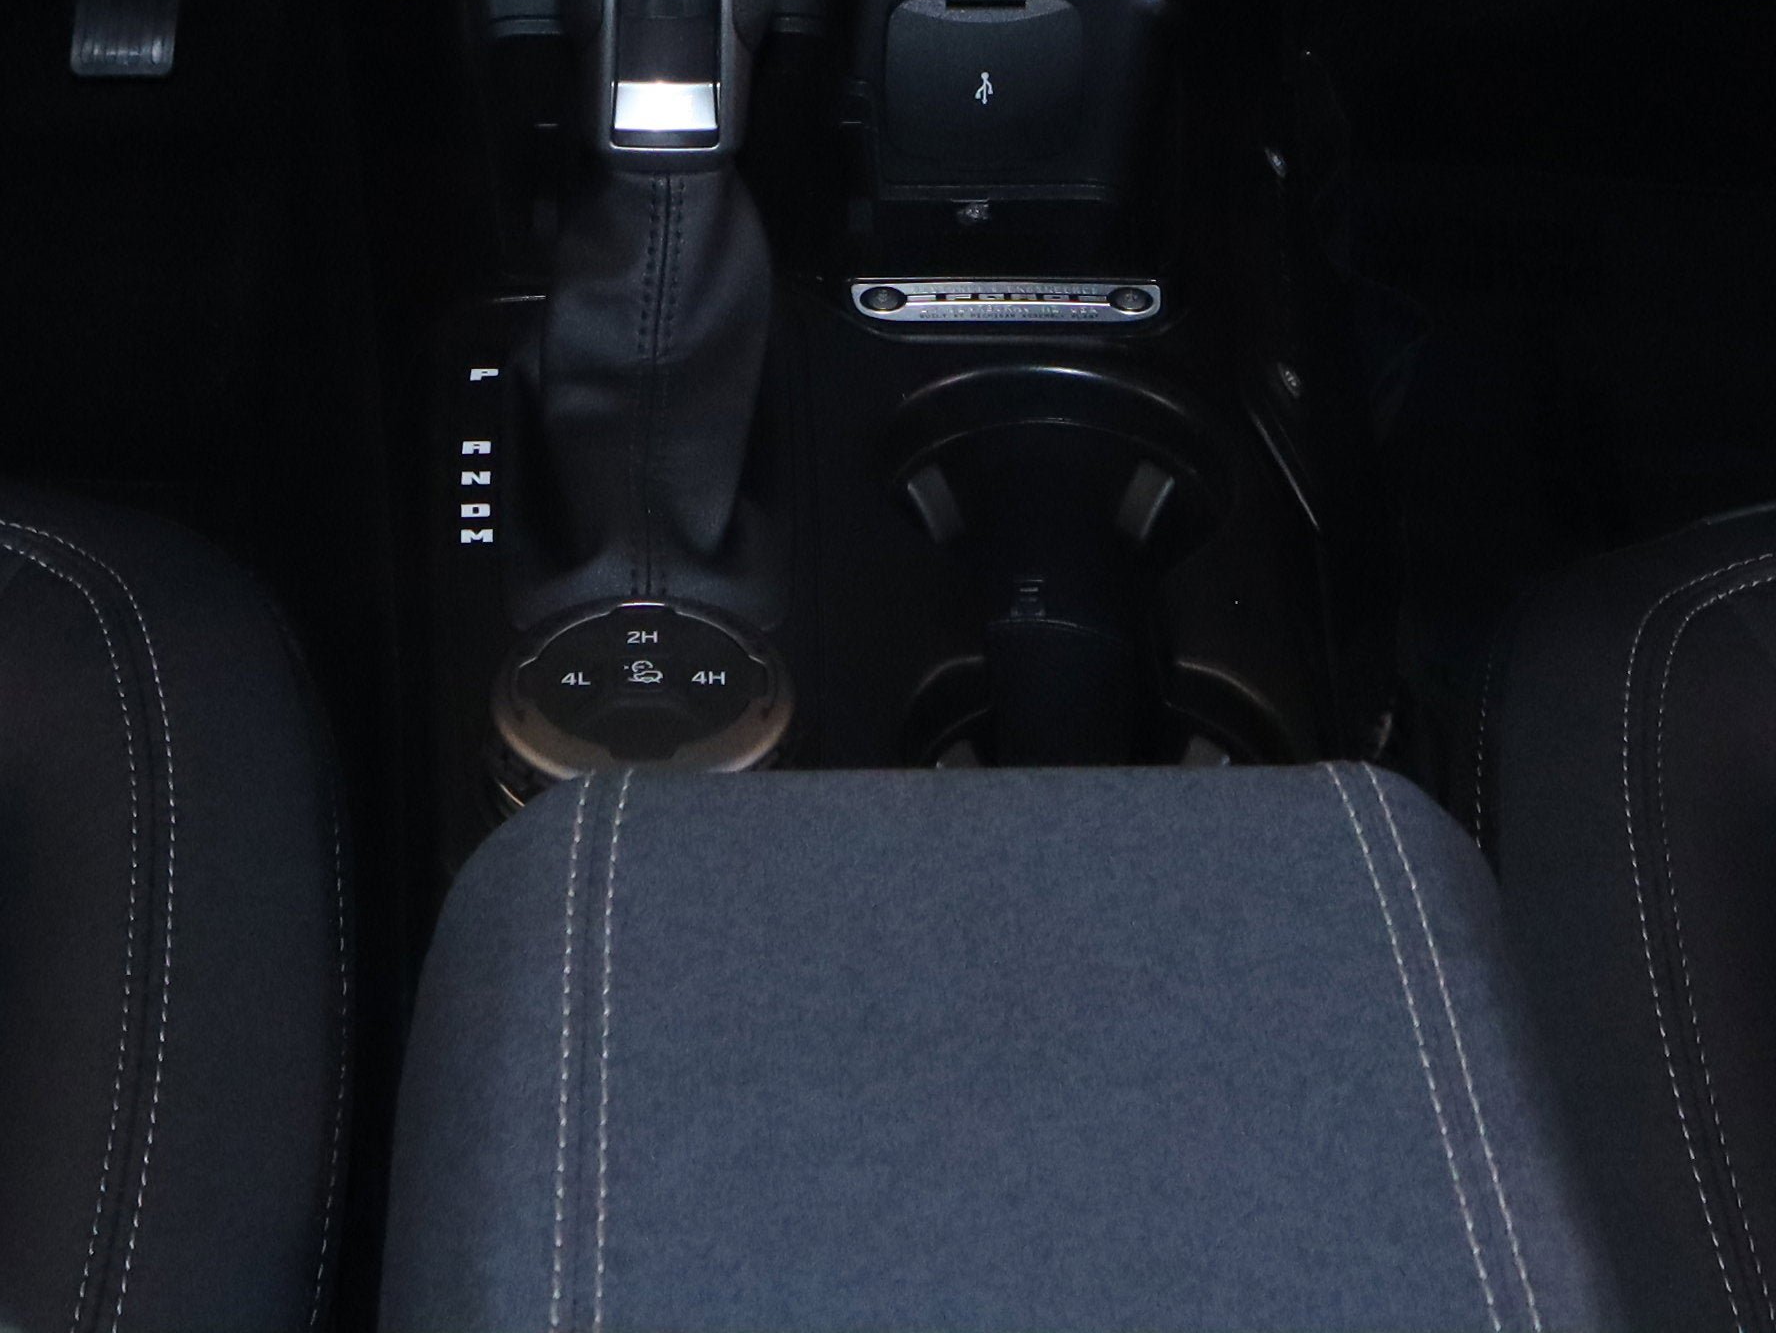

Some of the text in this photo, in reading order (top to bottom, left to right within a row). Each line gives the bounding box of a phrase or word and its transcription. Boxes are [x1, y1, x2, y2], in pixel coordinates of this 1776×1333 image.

[469, 368, 500, 382] P
[461, 470, 492, 486] N
[461, 503, 491, 518] D
[460, 528, 494, 544] M
[626, 630, 659, 644] 2H
[561, 672, 591, 685] 4L
[691, 670, 726, 685] 4H
